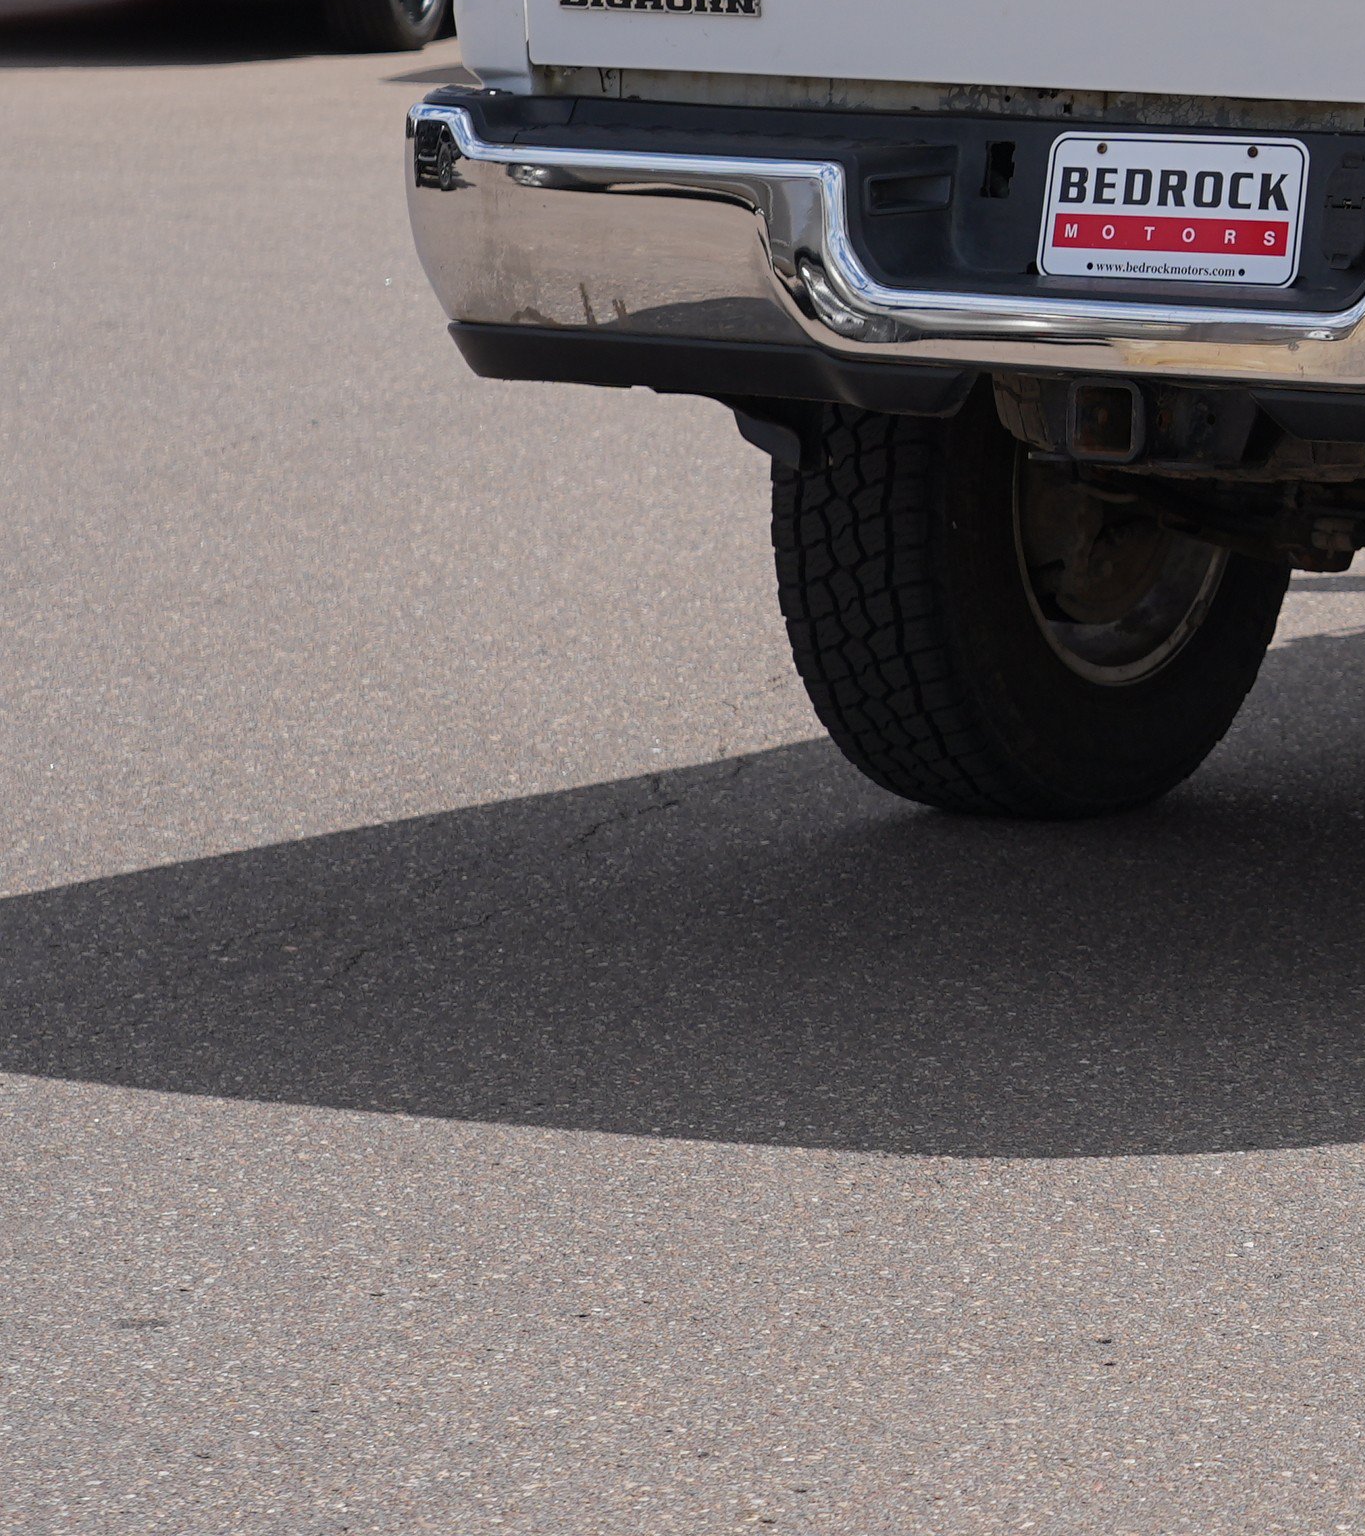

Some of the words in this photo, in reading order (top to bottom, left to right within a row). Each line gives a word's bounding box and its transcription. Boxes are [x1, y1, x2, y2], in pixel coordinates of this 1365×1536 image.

[1058, 166, 1290, 212] BEDROCK
[1064, 222, 1276, 247] MOTORS
[1096, 261, 1236, 277] www.bedrockmotors.com
